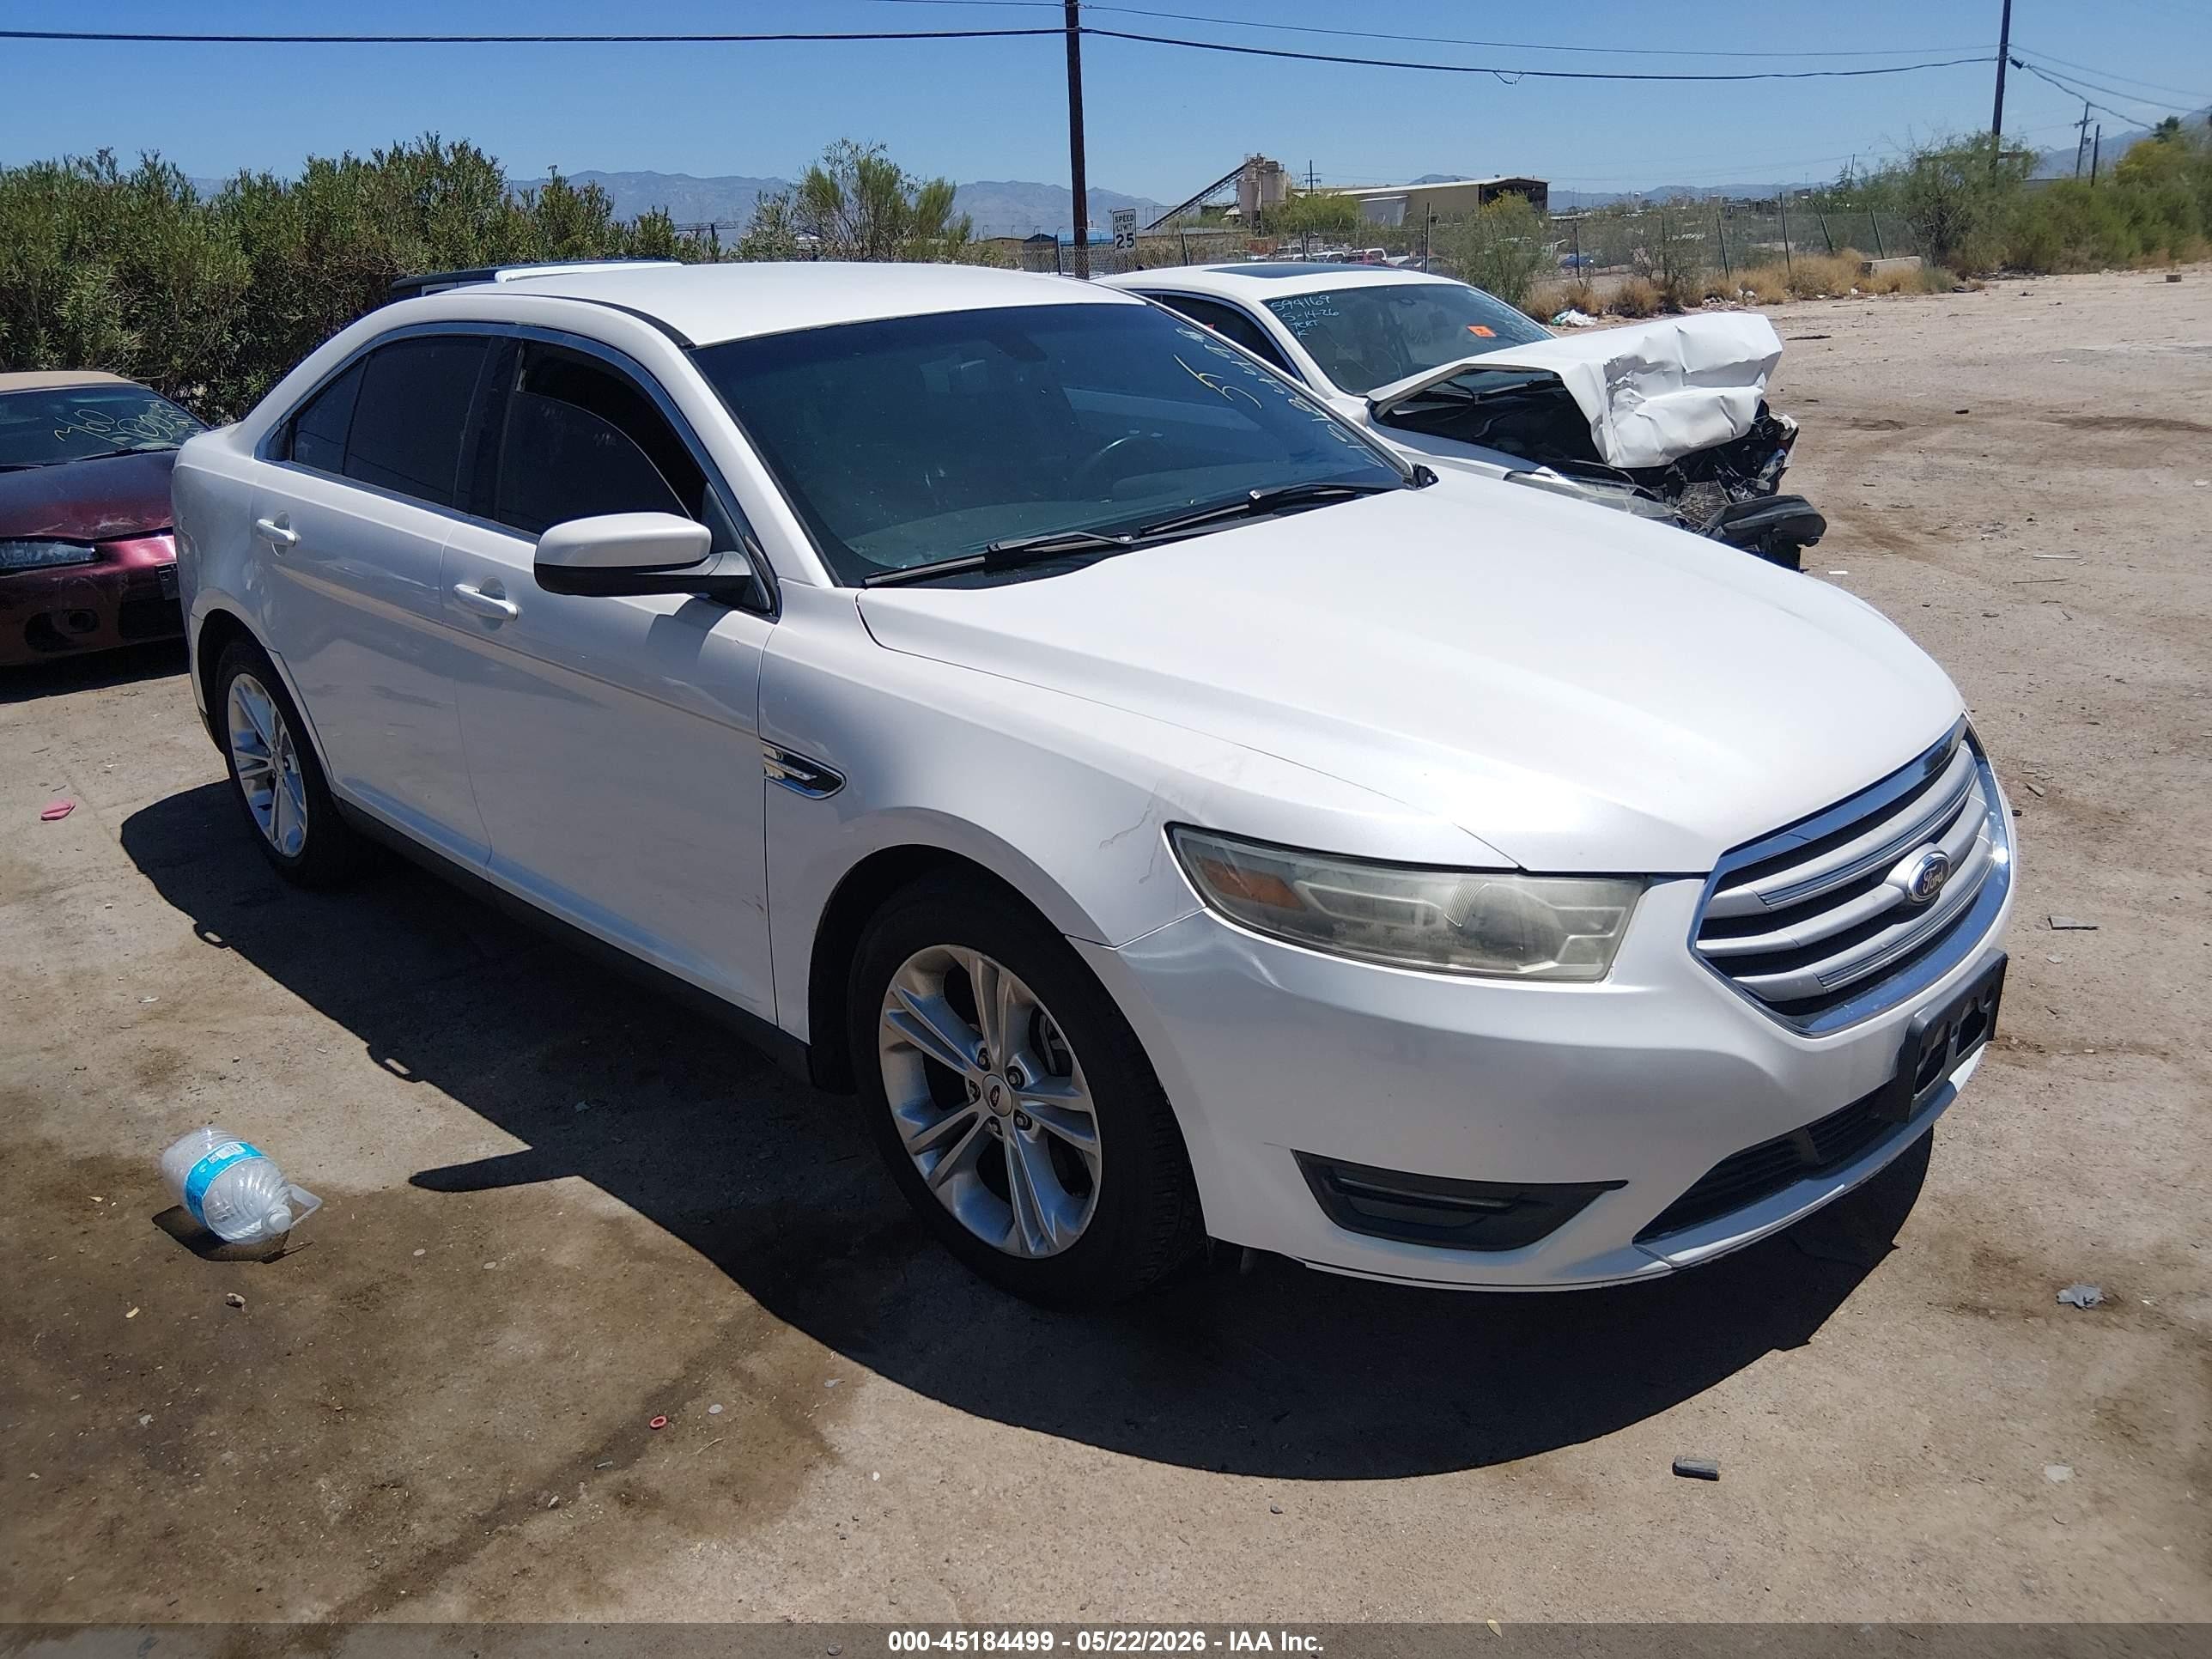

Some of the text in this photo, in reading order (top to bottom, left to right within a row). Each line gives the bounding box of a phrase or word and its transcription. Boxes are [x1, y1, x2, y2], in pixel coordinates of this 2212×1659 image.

[1115, 214, 1134, 222] SPEED
[1116, 223, 1133, 232] LIMIT
[1115, 233, 1134, 249] 25
[1923, 864, 1943, 894] Ford
